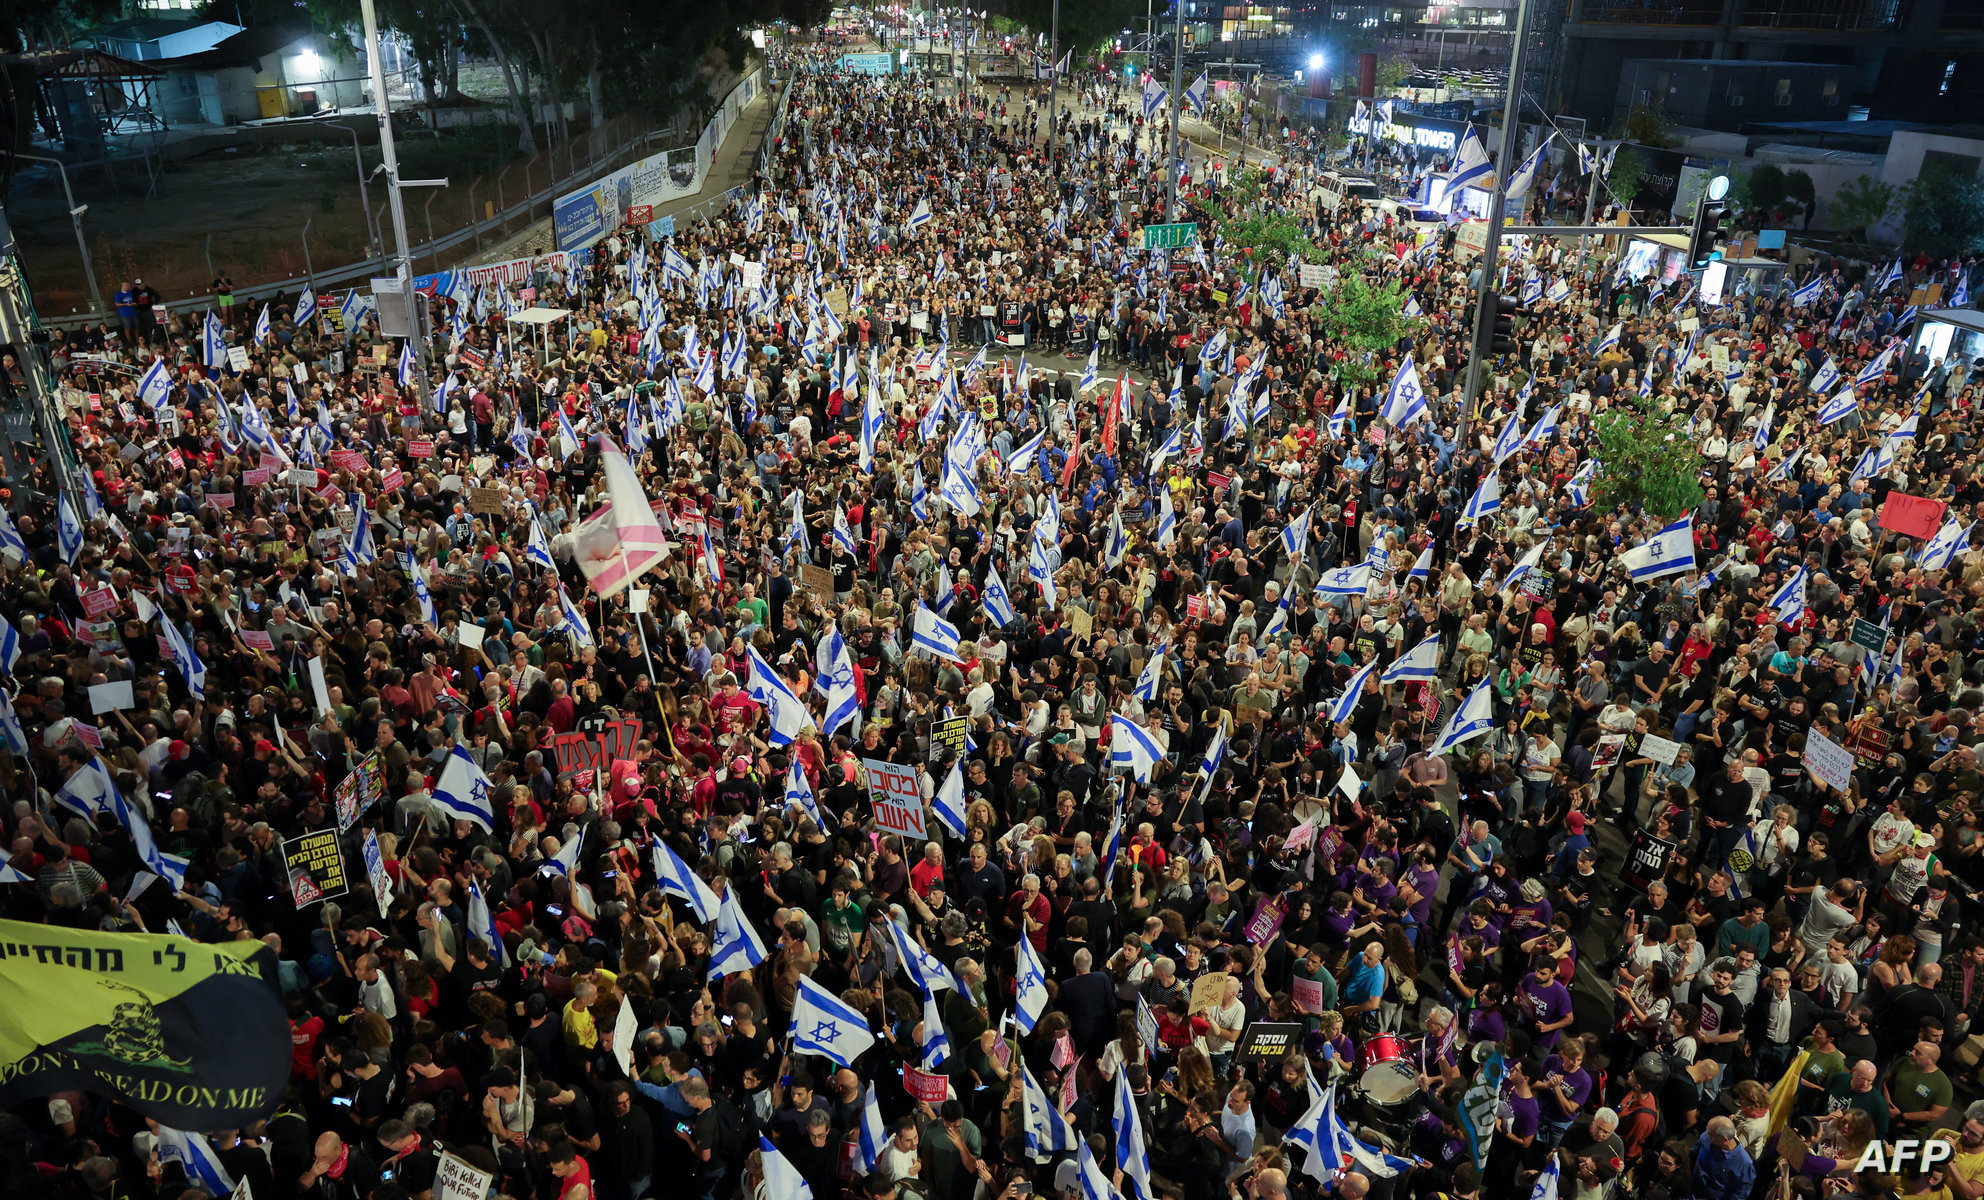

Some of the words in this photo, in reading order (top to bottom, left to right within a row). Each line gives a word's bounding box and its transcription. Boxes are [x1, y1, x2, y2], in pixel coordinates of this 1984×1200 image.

[1383, 124, 1414, 144] SPIRAL
[1415, 128, 1455, 148] TOWER
[584, 719, 605, 732] די
[943, 719, 966, 731] ממשלת
[949, 727, 965, 738] חורבן
[932, 731, 949, 741] הבית
[945, 735, 965, 746] קורעת
[955, 743, 964, 751] את
[884, 764, 900, 773] הוא
[865, 768, 918, 798] מסוכן
[892, 798, 905, 807] הוא
[872, 801, 923, 834] אשם
[300, 833, 334, 851] ממשלת
[1647, 840, 1666, 857] אל
[288, 850, 310, 867] הבית
[311, 844, 337, 859] חורבן
[1635, 848, 1662, 869] תתנו
[310, 854, 339, 871] קורעת
[1631, 861, 1643, 874] לו
[328, 865, 341, 878] את
[320, 876, 343, 891] העם!
[295, 889, 319, 906] סכנה!
[152, 943, 187, 973] לי
[1255, 1034, 1288, 1046] עסקה
[1249, 1045, 1286, 1055] עכשיו!
[175, 1085, 220, 1109] ON
[224, 1087, 266, 1110] ME
